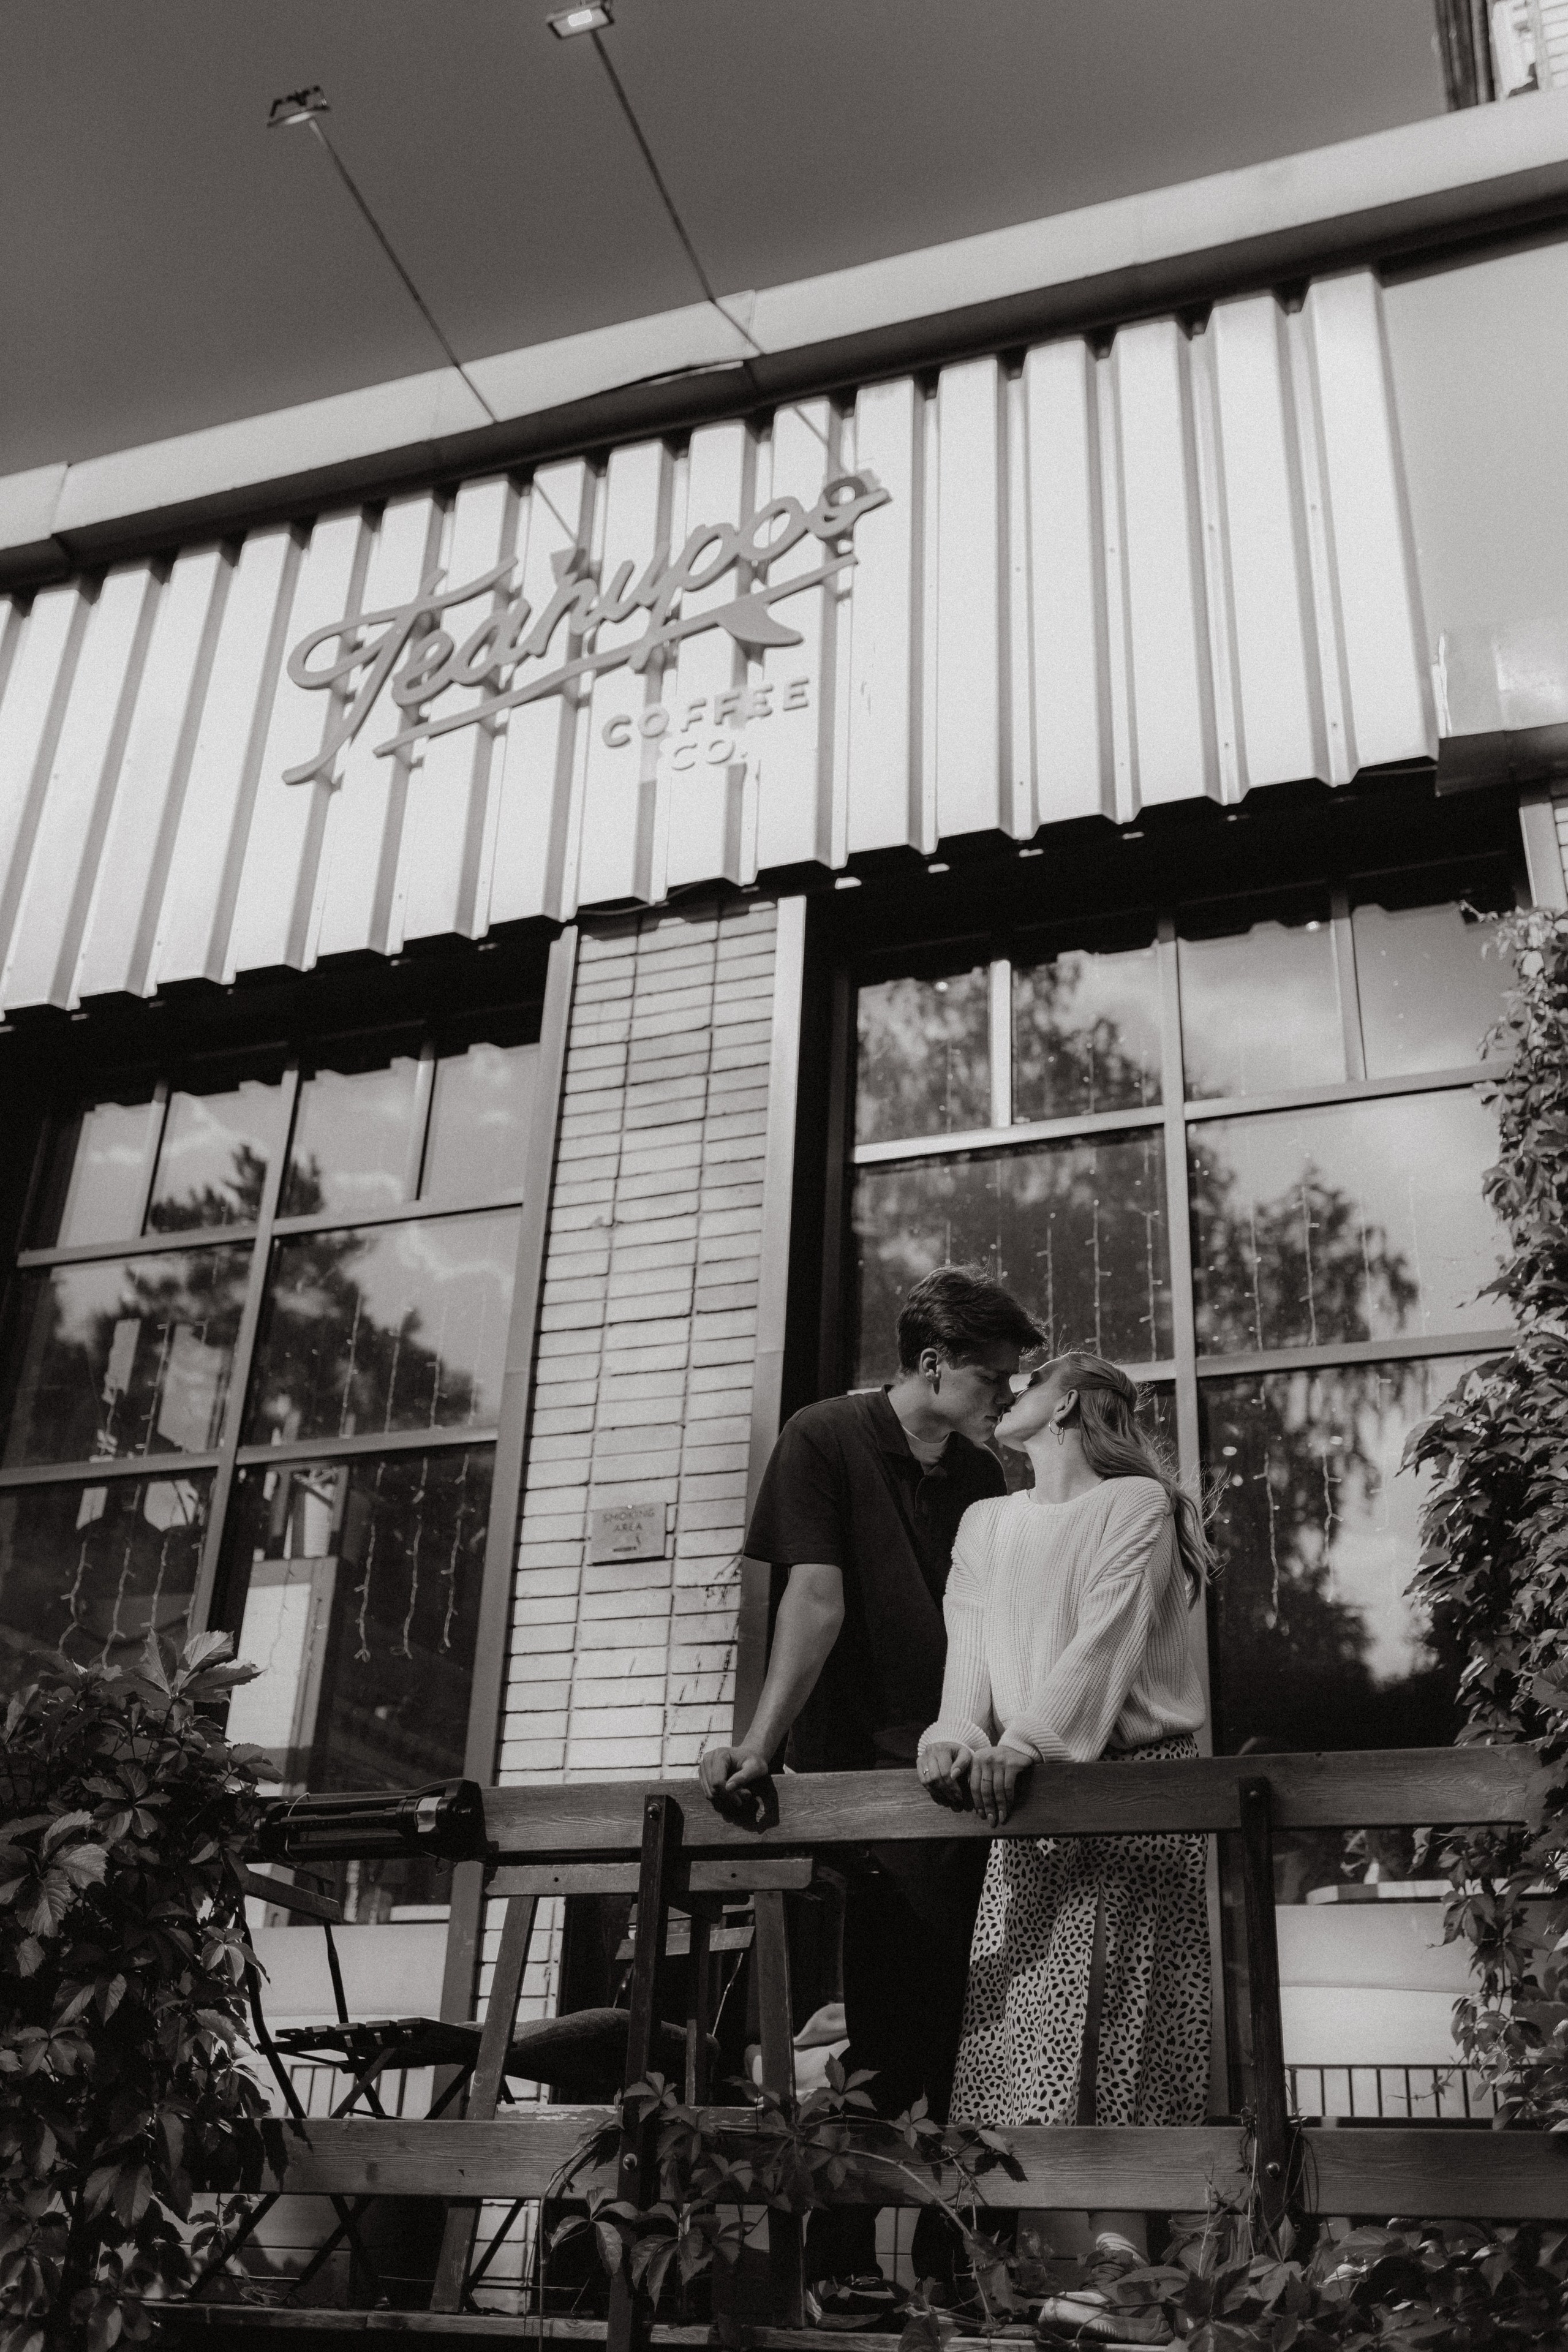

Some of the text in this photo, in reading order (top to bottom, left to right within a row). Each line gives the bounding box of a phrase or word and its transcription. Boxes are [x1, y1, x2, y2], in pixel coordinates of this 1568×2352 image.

[601, 676, 809, 748] COFFEE
[602, 1507, 656, 1523] SMOKING
[613, 1521, 643, 1532] AREA
